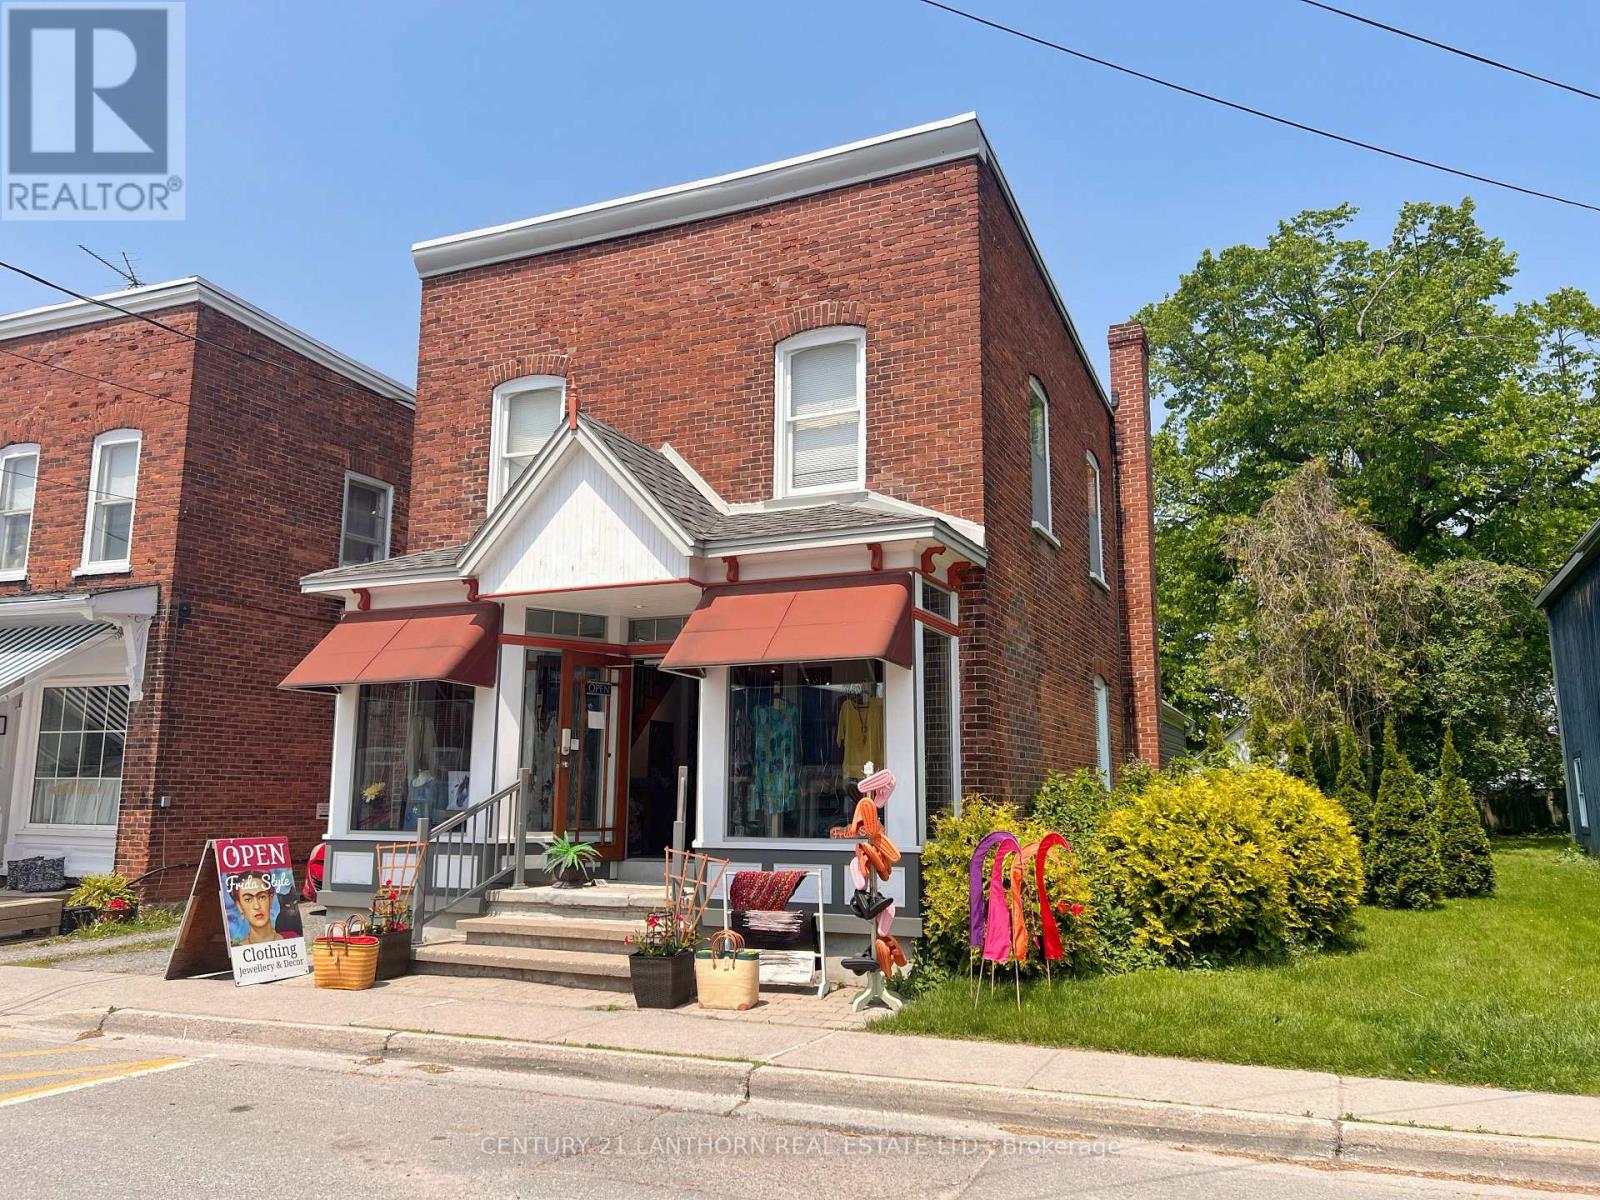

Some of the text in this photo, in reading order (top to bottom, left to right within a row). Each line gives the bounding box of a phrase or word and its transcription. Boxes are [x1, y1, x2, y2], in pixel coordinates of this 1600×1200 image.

[588, 683, 609, 694] OPEN
[222, 843, 286, 868] OPEN
[225, 873, 292, 893] Frida Style
[243, 944, 298, 963] Clothing
[239, 962, 275, 977] Jewellery
[283, 958, 304, 968] Decor
